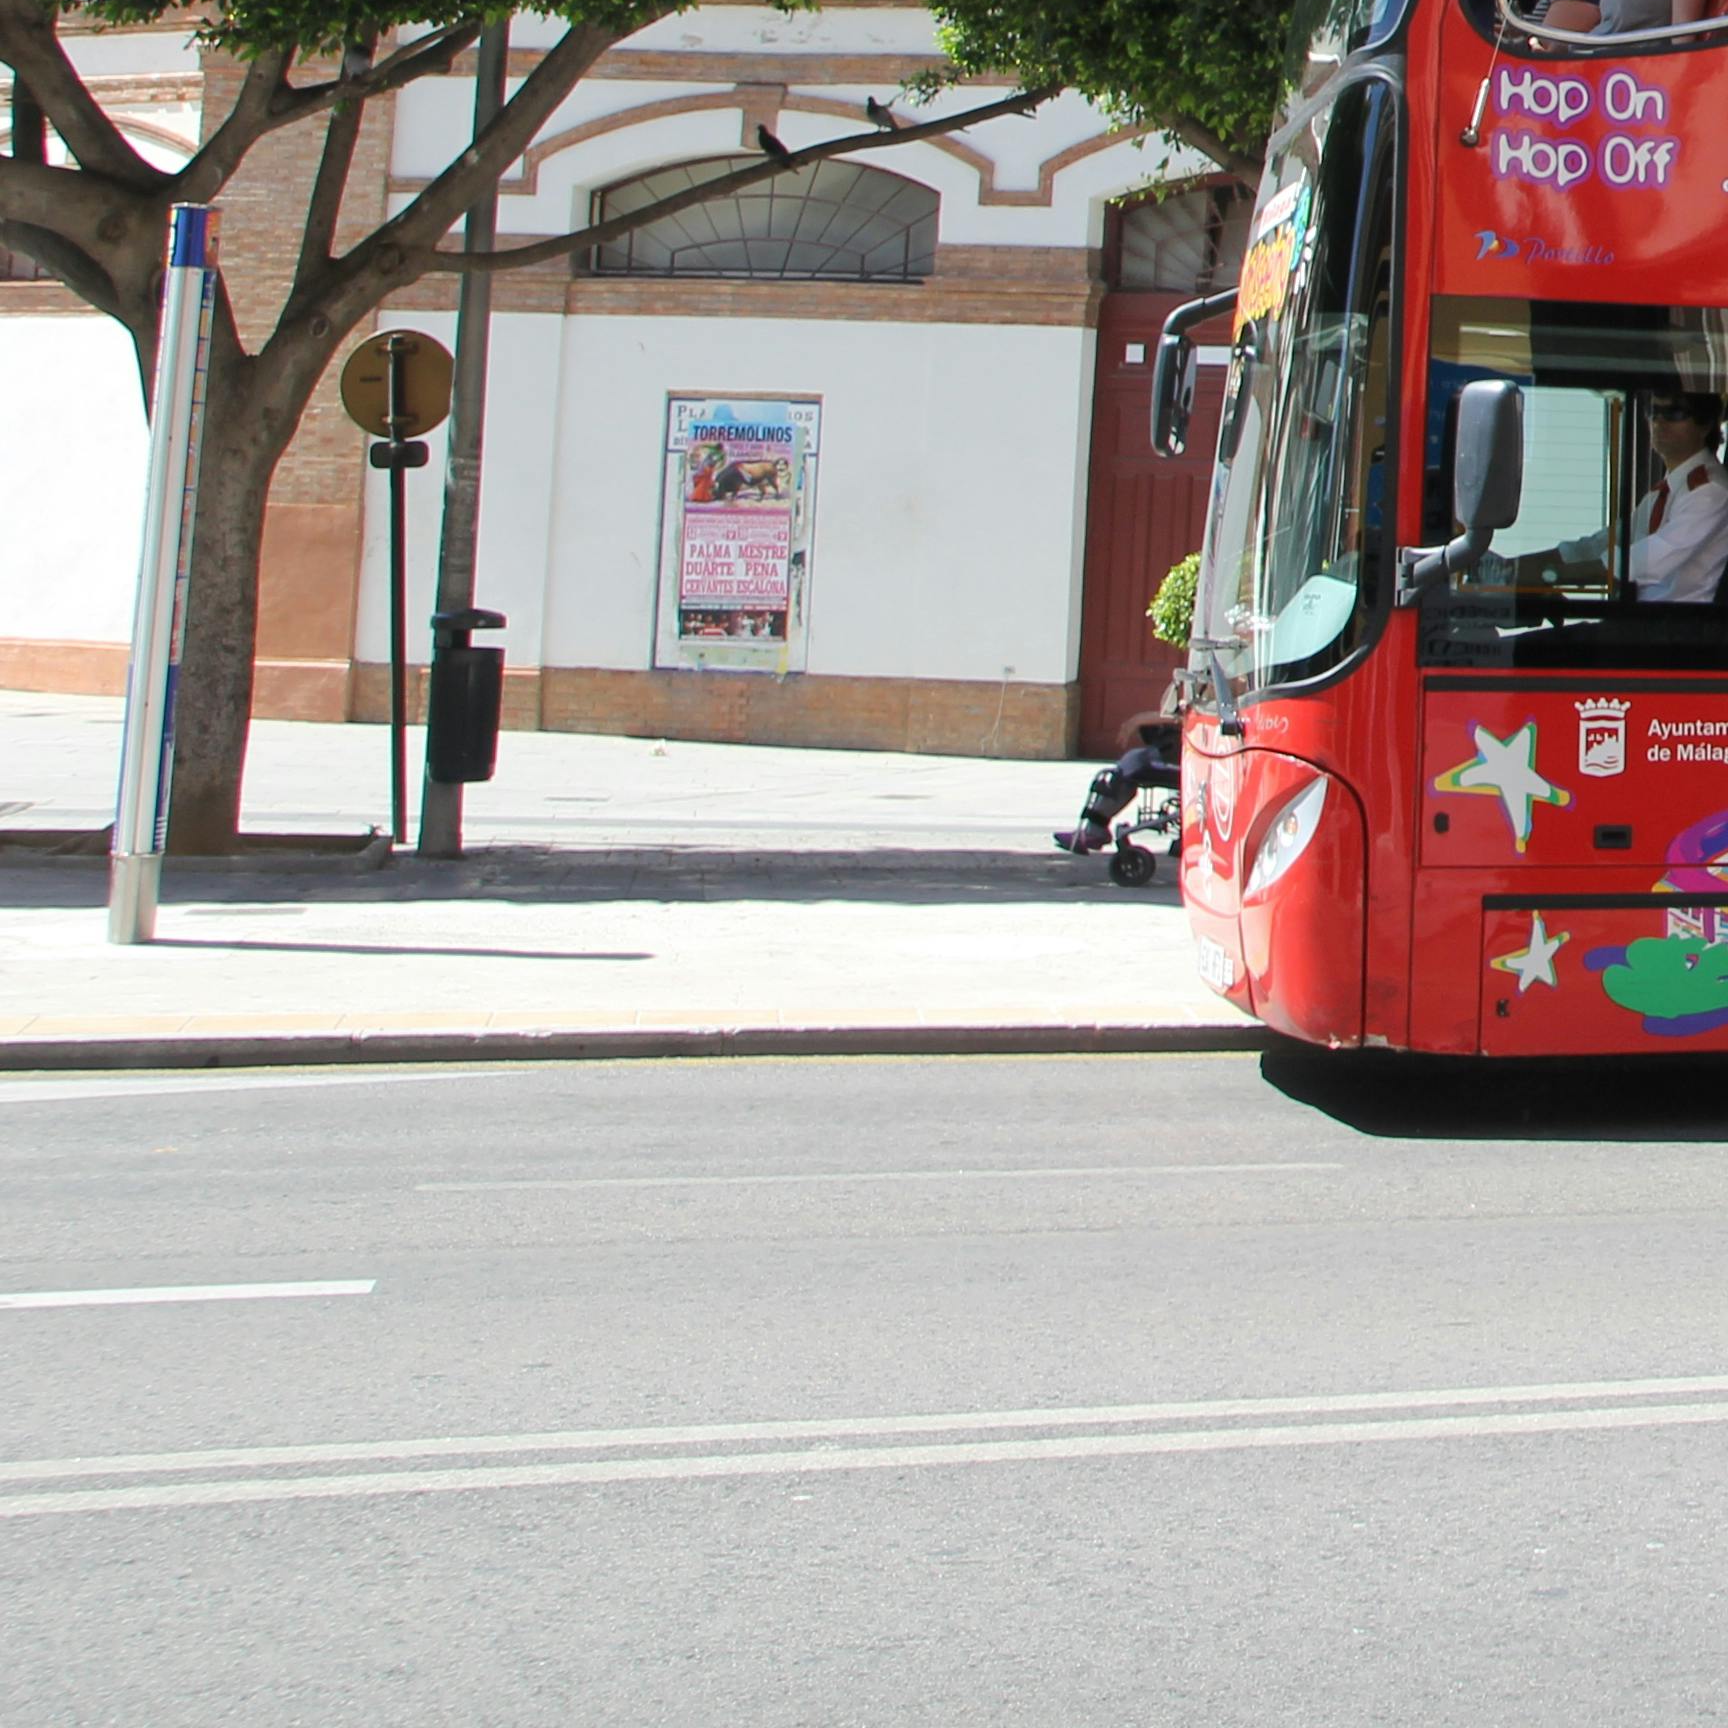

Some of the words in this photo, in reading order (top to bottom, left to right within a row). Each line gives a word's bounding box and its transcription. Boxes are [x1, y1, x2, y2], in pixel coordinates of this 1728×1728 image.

[1501, 70, 1589, 122] Hop
[1605, 73, 1664, 120] On
[1499, 134, 1587, 186] Hop
[1604, 136, 1674, 184] Off
[693, 425, 793, 443] TORREMOLINOS
[690, 544, 731, 559] PALMA
[738, 545, 787, 560] MESTRE
[686, 562, 735, 576] DUARTE
[1647, 745, 1671, 761] de
